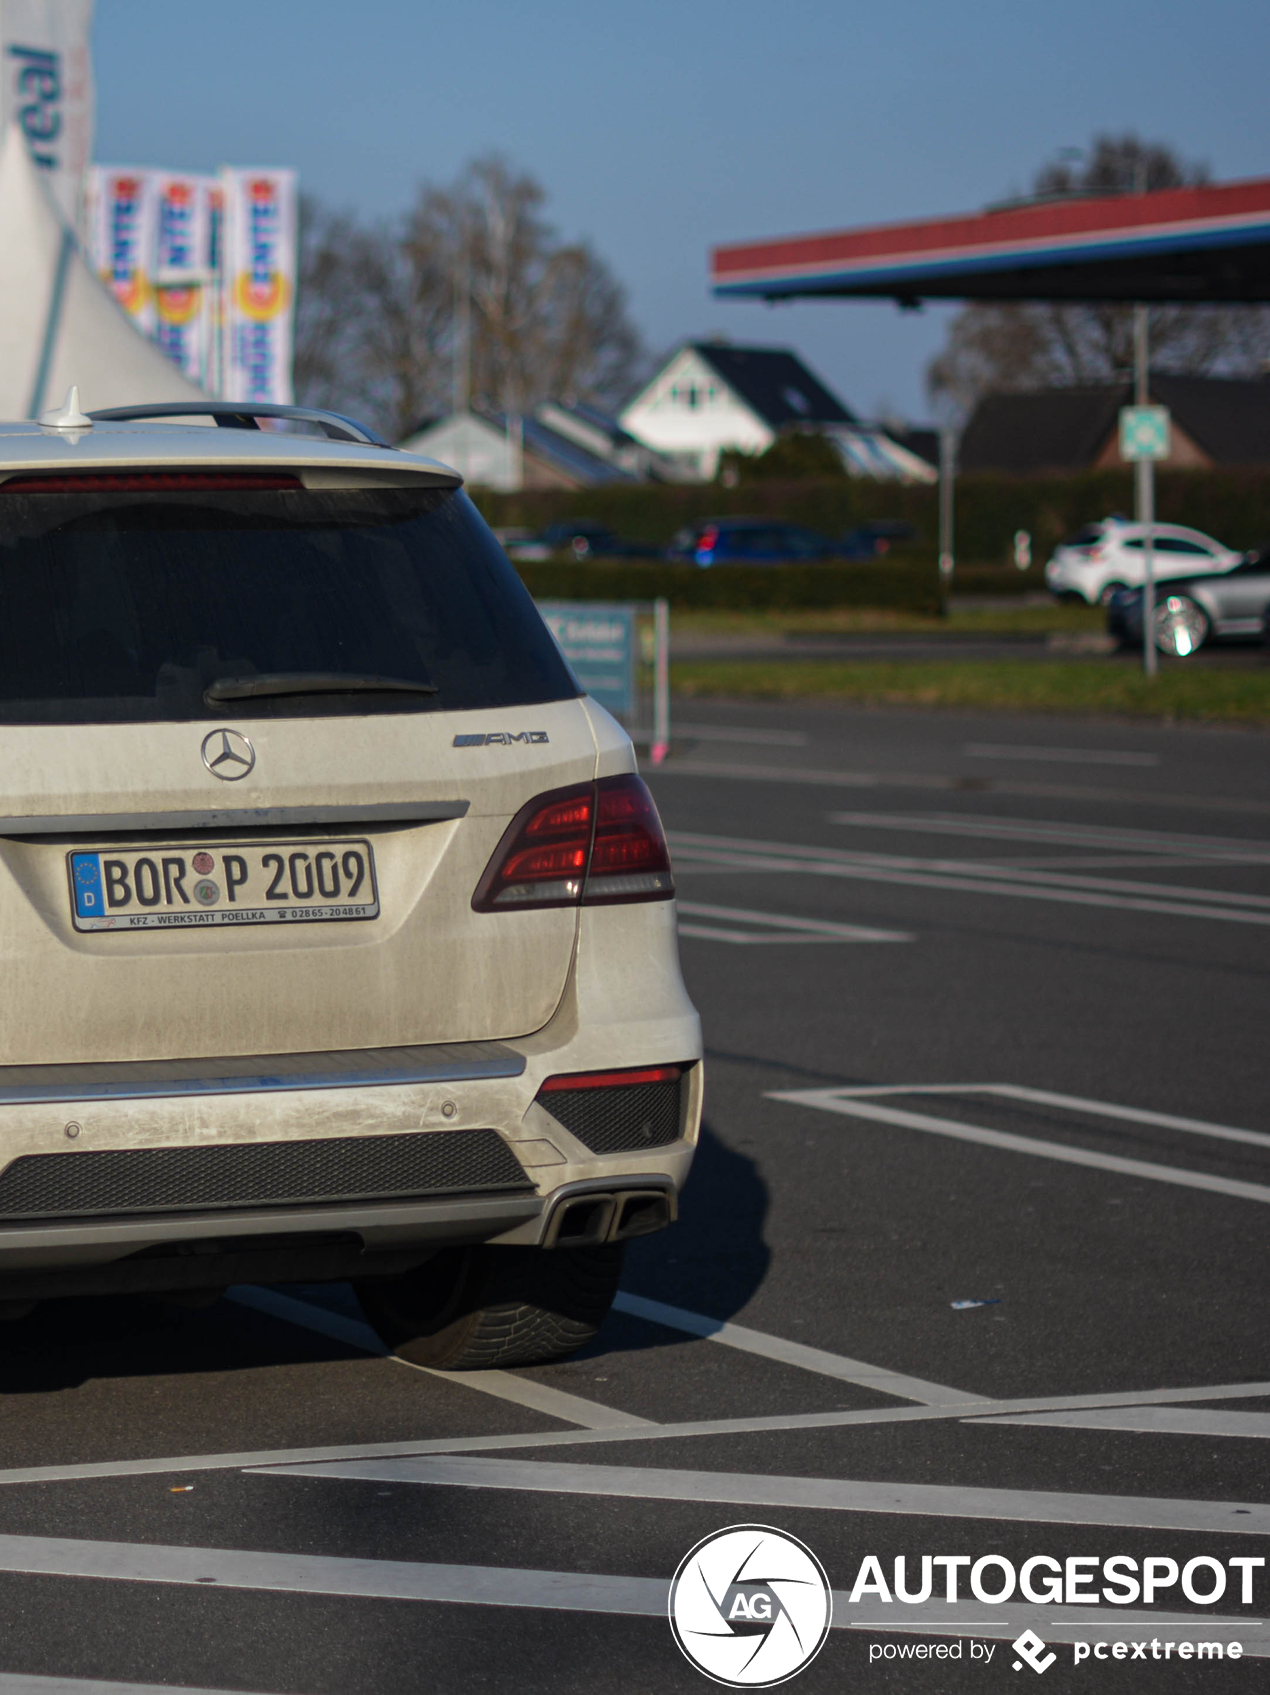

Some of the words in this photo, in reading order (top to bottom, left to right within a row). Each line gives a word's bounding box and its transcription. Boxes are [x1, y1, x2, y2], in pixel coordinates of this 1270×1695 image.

[484, 731, 549, 746] AMG
[103, 857, 191, 908] BOR
[222, 855, 249, 902] P
[261, 851, 365, 901] 2009
[83, 892, 96, 906] D
[130, 917, 149, 926] KFZ
[157, 913, 216, 925] WERKSTATT
[221, 911, 266, 922] POELLKA
[292, 907, 367, 919] 02865-204861
